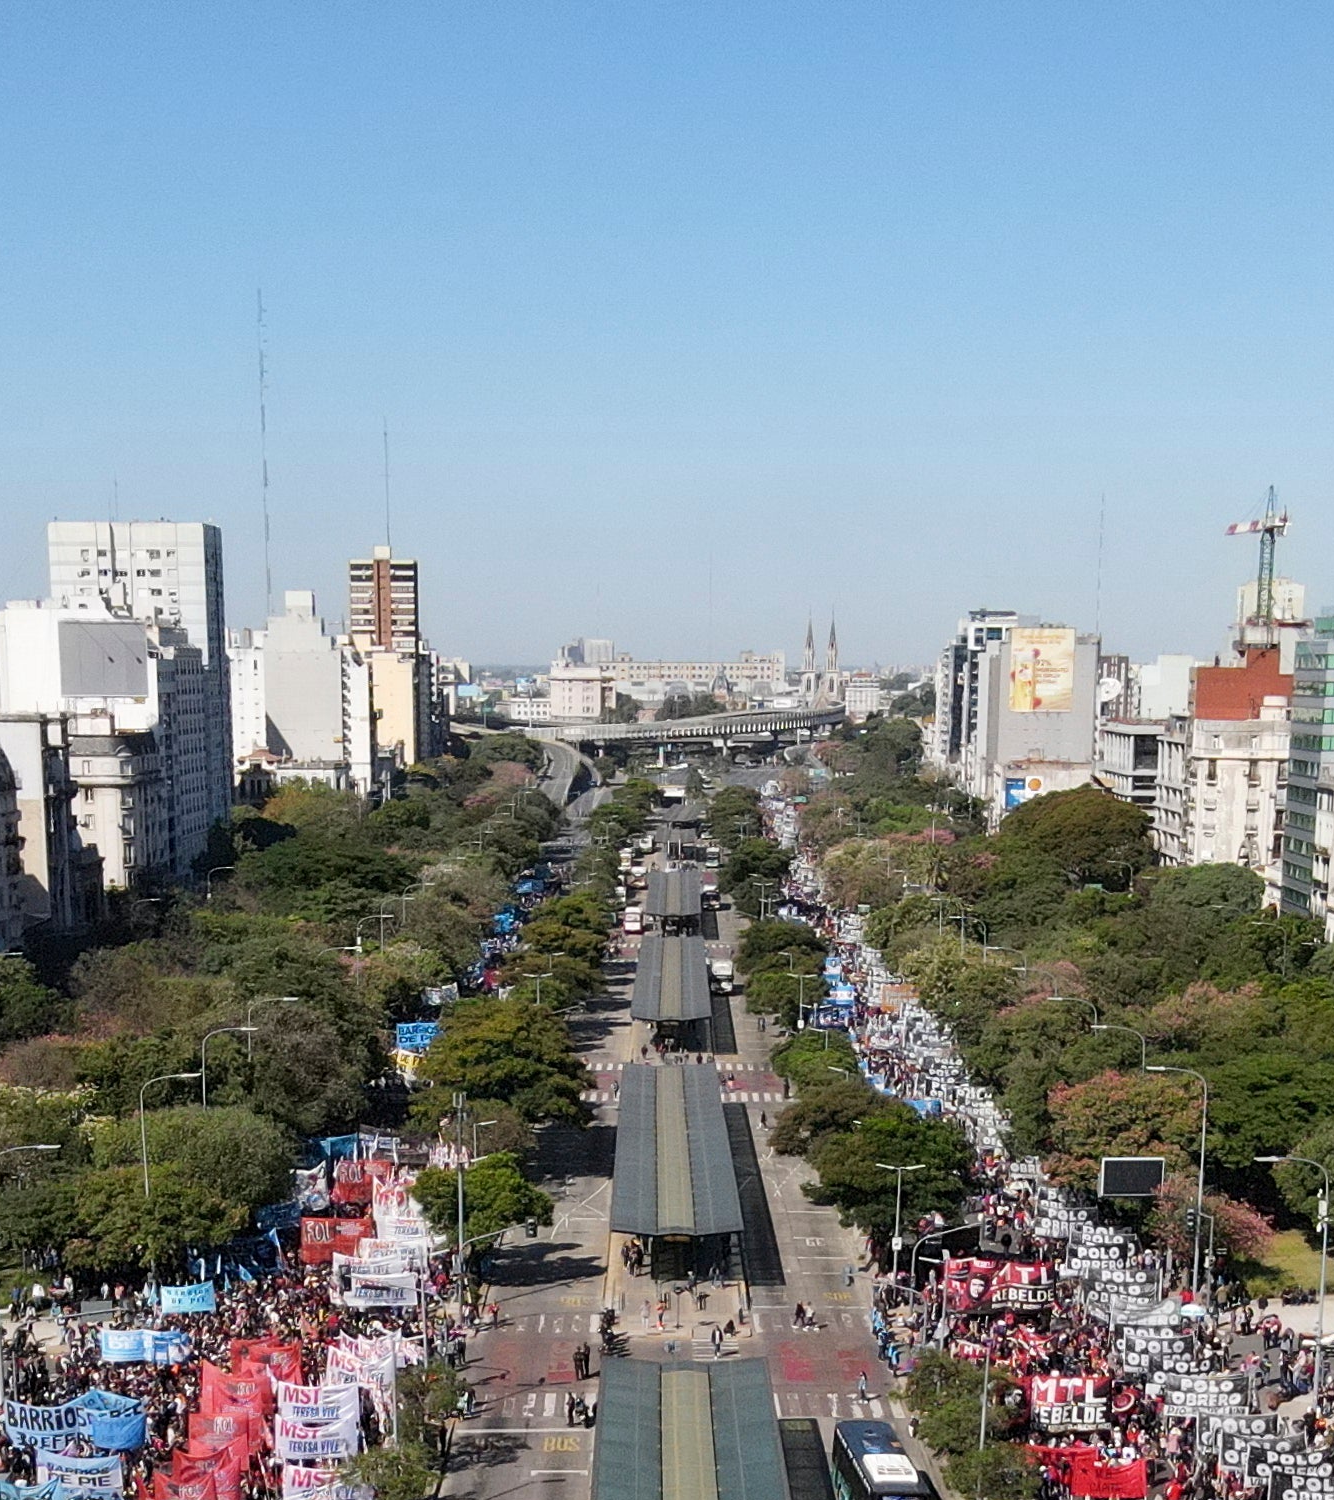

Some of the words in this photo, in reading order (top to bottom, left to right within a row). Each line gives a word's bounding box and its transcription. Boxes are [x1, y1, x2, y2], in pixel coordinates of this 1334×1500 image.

[1048, 1209, 1088, 1221] POLO
[1077, 1246, 1120, 1259] POLO
[1102, 1271, 1147, 1283] POLO
[1095, 1282, 1140, 1295] POLO
[1135, 1339, 1184, 1354] POLO
[1163, 1359, 1210, 1374] POLO
[1032, 1376, 1107, 1404] MTL
[1181, 1378, 1234, 1393] POLO
[284, 1388, 321, 1405] MST
[1172, 1393, 1242, 1406] OBRERO
[292, 1406, 319, 1418] TERESA
[322, 1406, 340, 1419] VIVE
[280, 1419, 319, 1440] MST
[1210, 1418, 1266, 1435] POLO
[289, 1440, 318, 1453] TERESA
[321, 1440, 339, 1453] VIVE
[1267, 1452, 1323, 1466] POLO
[78, 1475, 112, 1486] PIE
